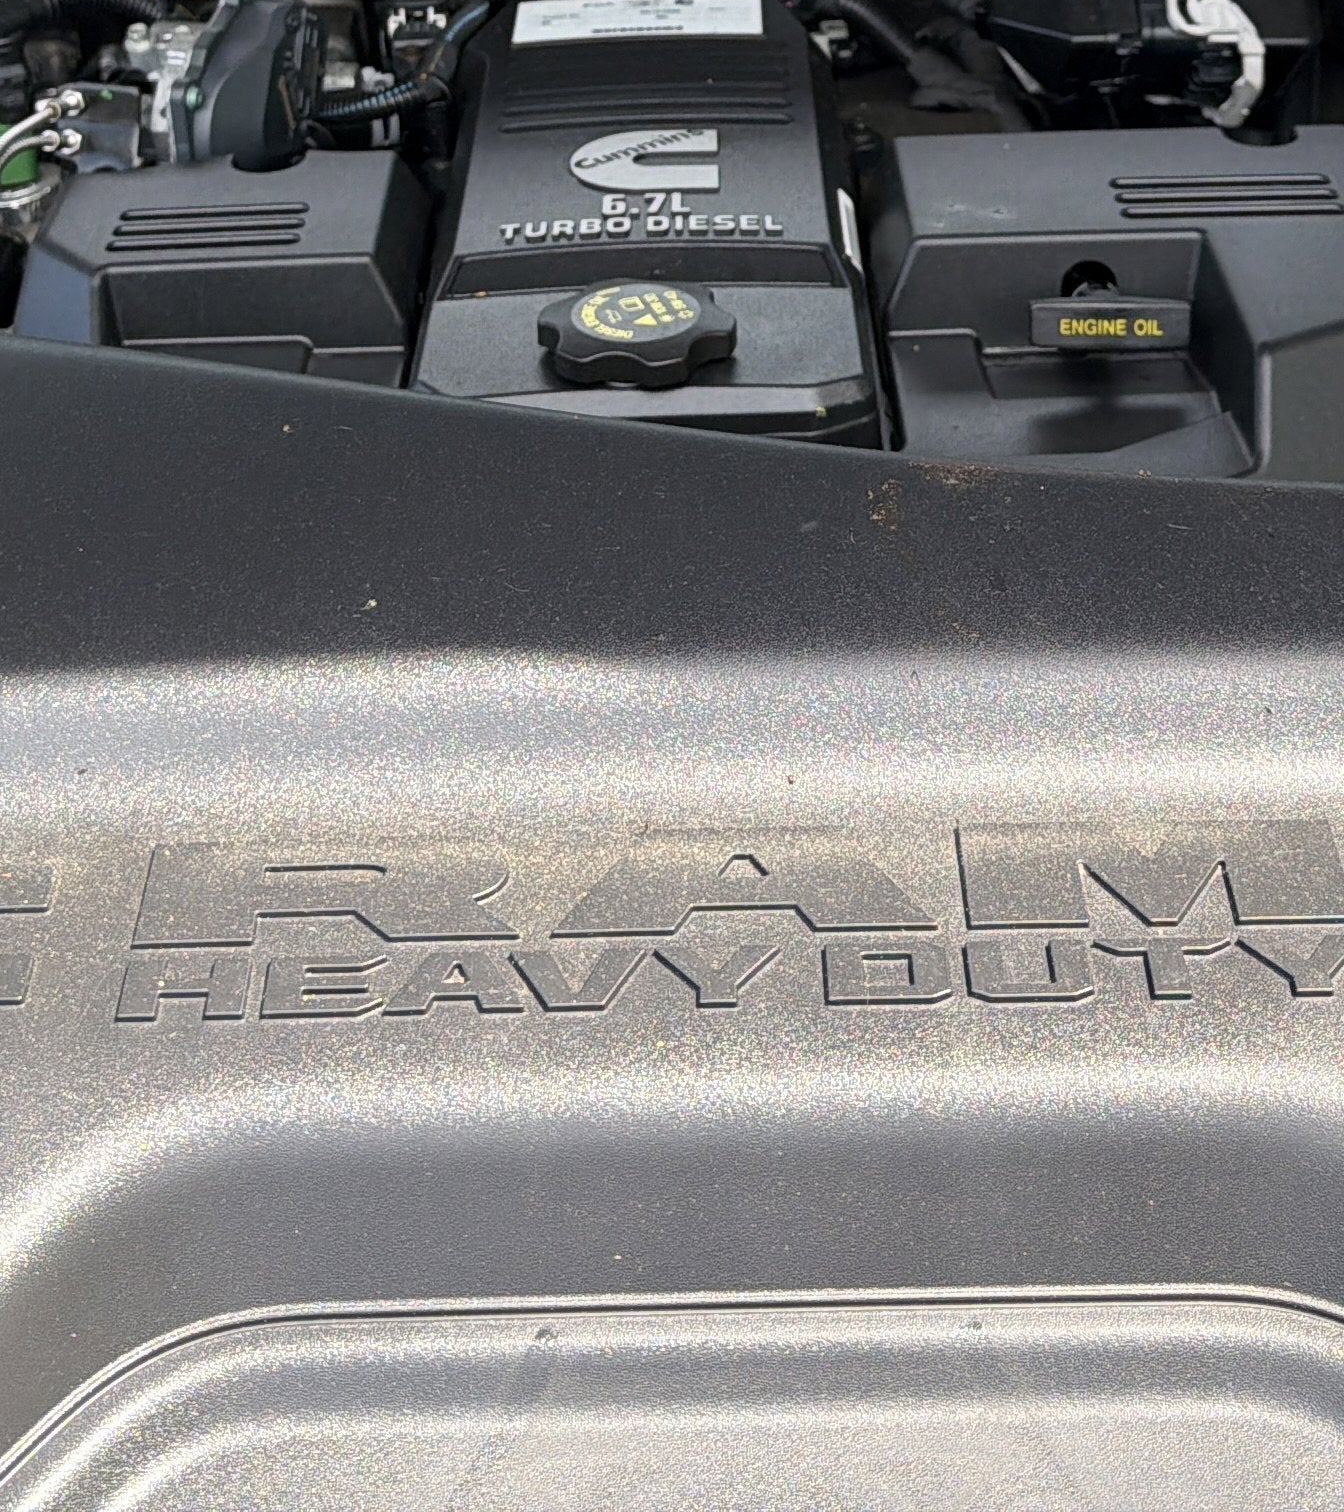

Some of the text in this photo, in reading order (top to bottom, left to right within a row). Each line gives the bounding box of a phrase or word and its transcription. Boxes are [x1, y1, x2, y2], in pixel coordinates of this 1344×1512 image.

[601, 191, 692, 216] 6.7L
[500, 213, 784, 242] TURBO DIESEL
[1059, 318, 1165, 337] ENGINE OIL
[114, 944, 781, 1024] HEAVY
